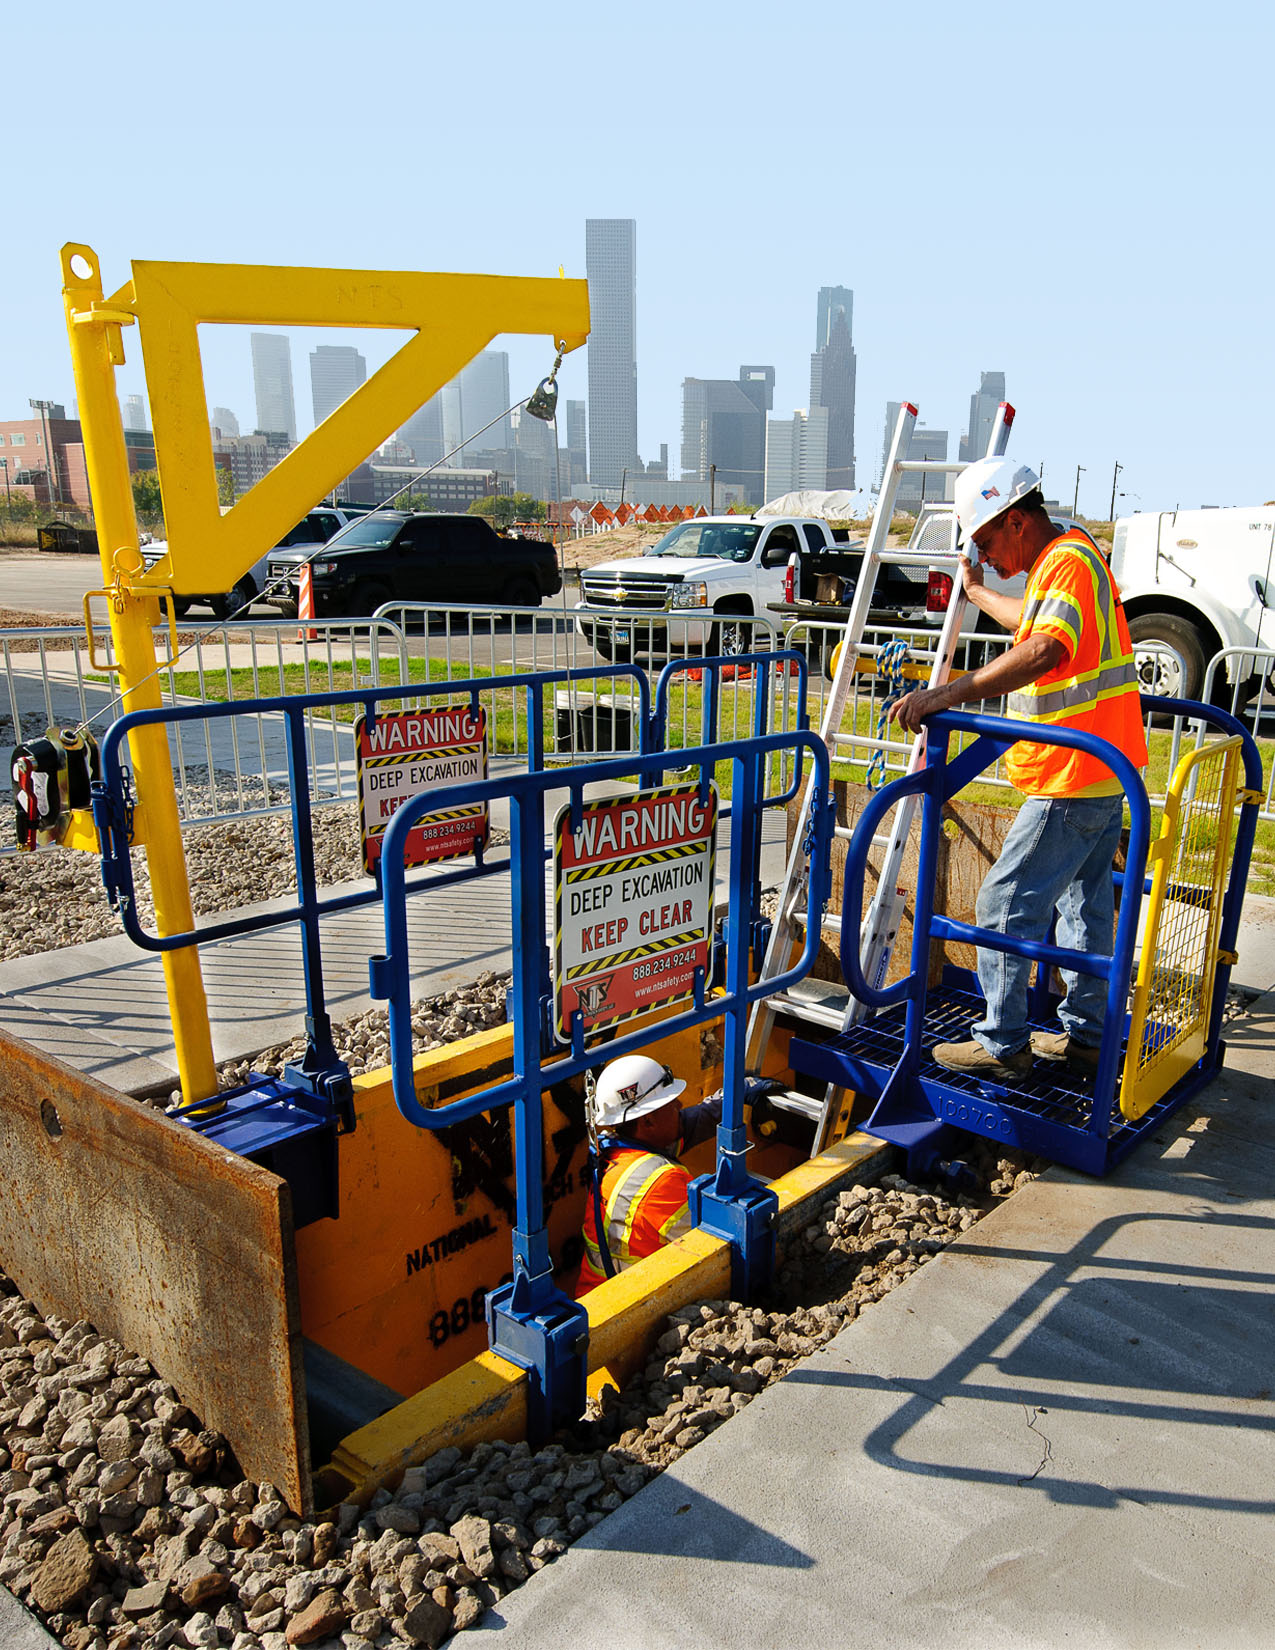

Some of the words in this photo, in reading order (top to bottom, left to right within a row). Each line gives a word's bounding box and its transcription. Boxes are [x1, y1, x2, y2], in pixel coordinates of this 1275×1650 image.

[1248, 523, 1261, 531] UNIT
[370, 713, 476, 752] WARNING
[370, 770, 403, 791] DEEP
[410, 759, 478, 784] EXCAVATION
[423, 820, 476, 840] 888.234.9244
[573, 797, 705, 860] WARNING
[571, 884, 613, 916] DEEP
[622, 861, 704, 902] EXCAVATION
[581, 917, 628, 953] KEEP
[639, 899, 693, 936] CLEAR
[632, 948, 697, 981] 888.234.9244
[634, 971, 694, 998] www.ntsafety.com
[406, 1214, 498, 1276] NATIONAL
